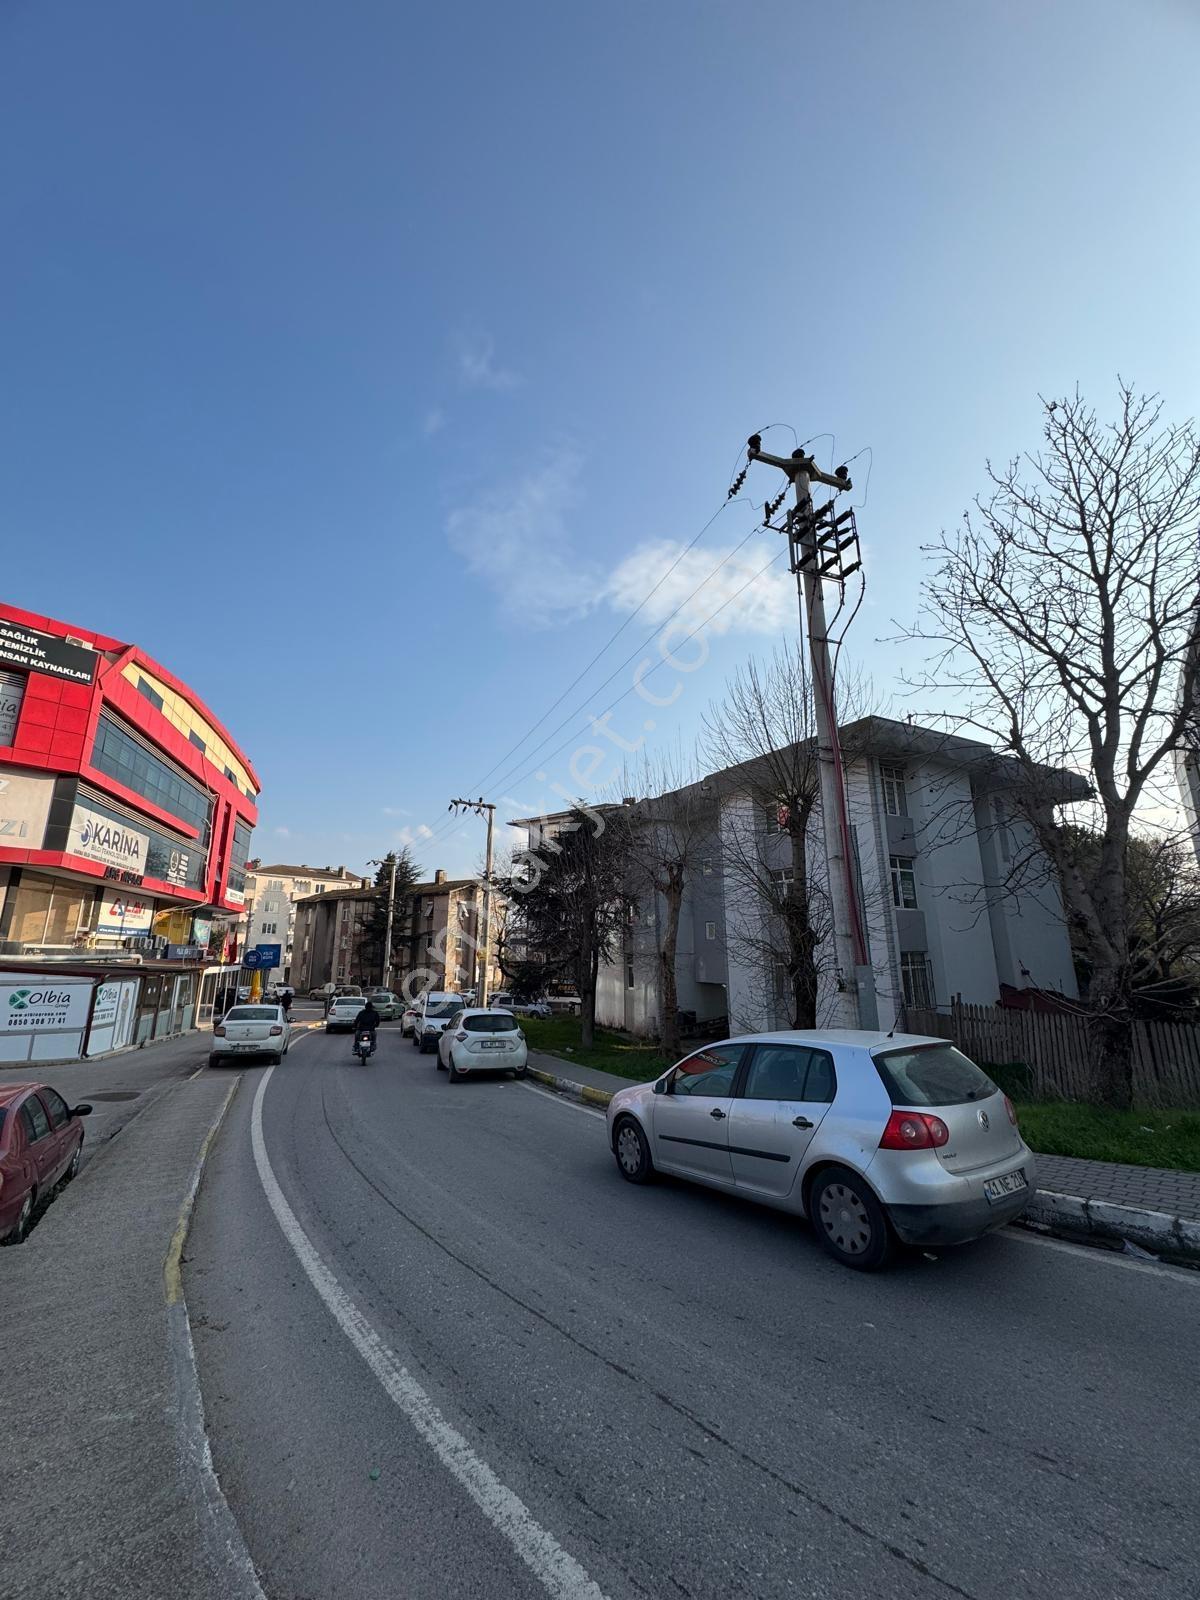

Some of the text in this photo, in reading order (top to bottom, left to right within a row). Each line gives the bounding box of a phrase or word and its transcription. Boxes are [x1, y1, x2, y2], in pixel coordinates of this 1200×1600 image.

[0, 628, 38, 646] SAĞLIK
[0, 639, 46, 658] TEMİZLİK
[30, 659, 91, 681] KAYNAKLARI
[93, 823, 139, 859] KARİNA
[29, 991, 71, 1005] Olbia
